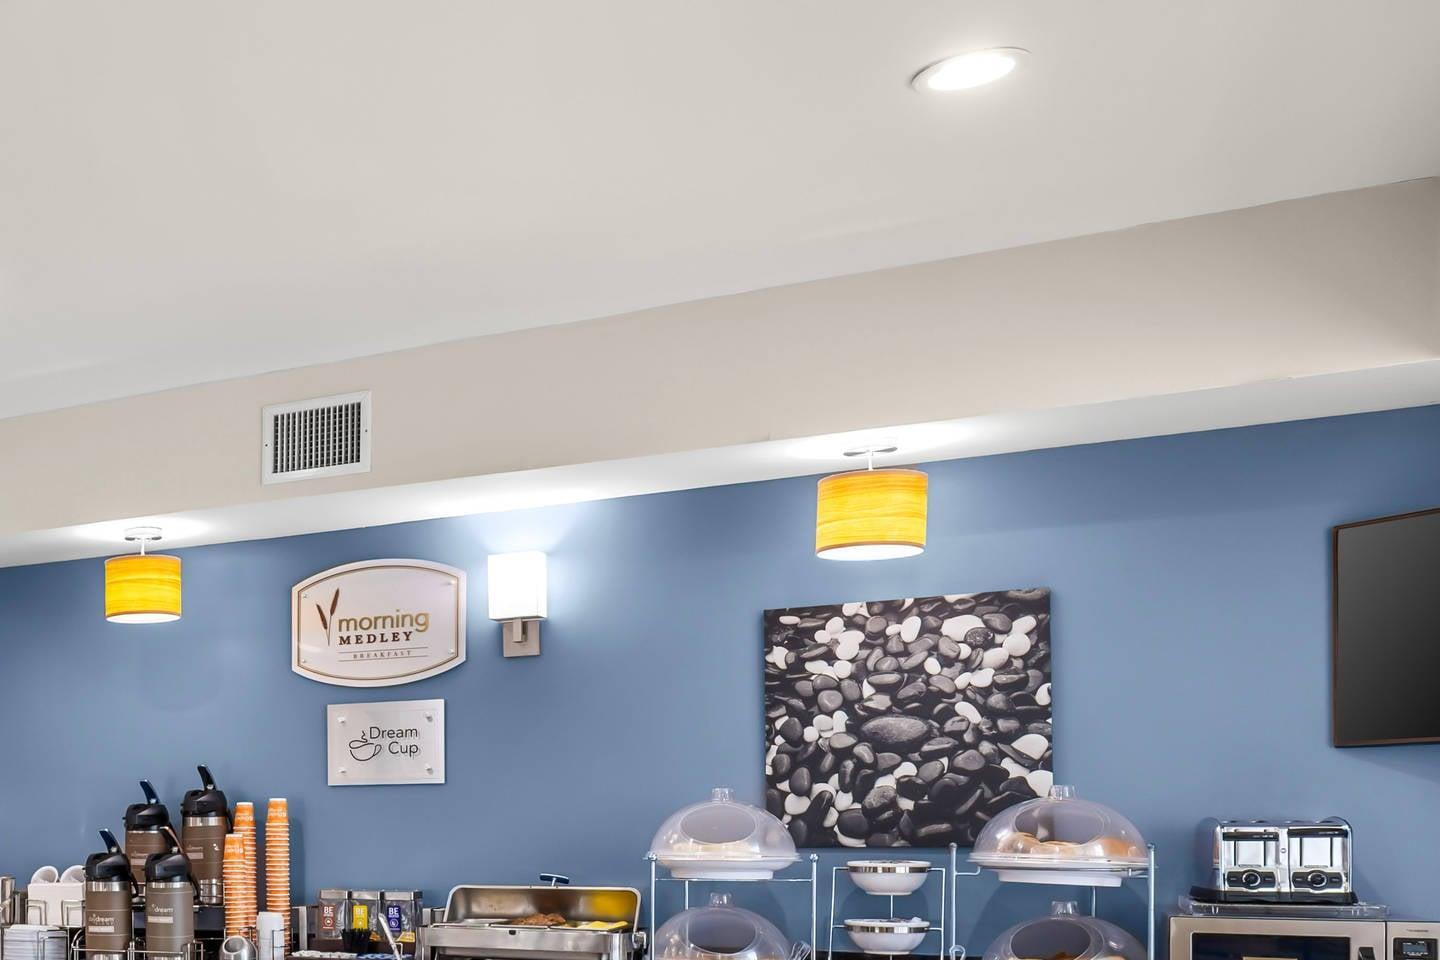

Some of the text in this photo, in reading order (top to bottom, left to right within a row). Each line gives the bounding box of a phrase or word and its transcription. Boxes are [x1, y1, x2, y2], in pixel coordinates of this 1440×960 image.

[338, 609, 429, 633] morning
[339, 631, 413, 645] MEDLEY
[353, 650, 412, 659] BREAKFAST
[369, 726, 418, 739] Dream
[388, 741, 419, 758] Cup
[323, 906, 334, 914] BE
[388, 907, 399, 915] BE
